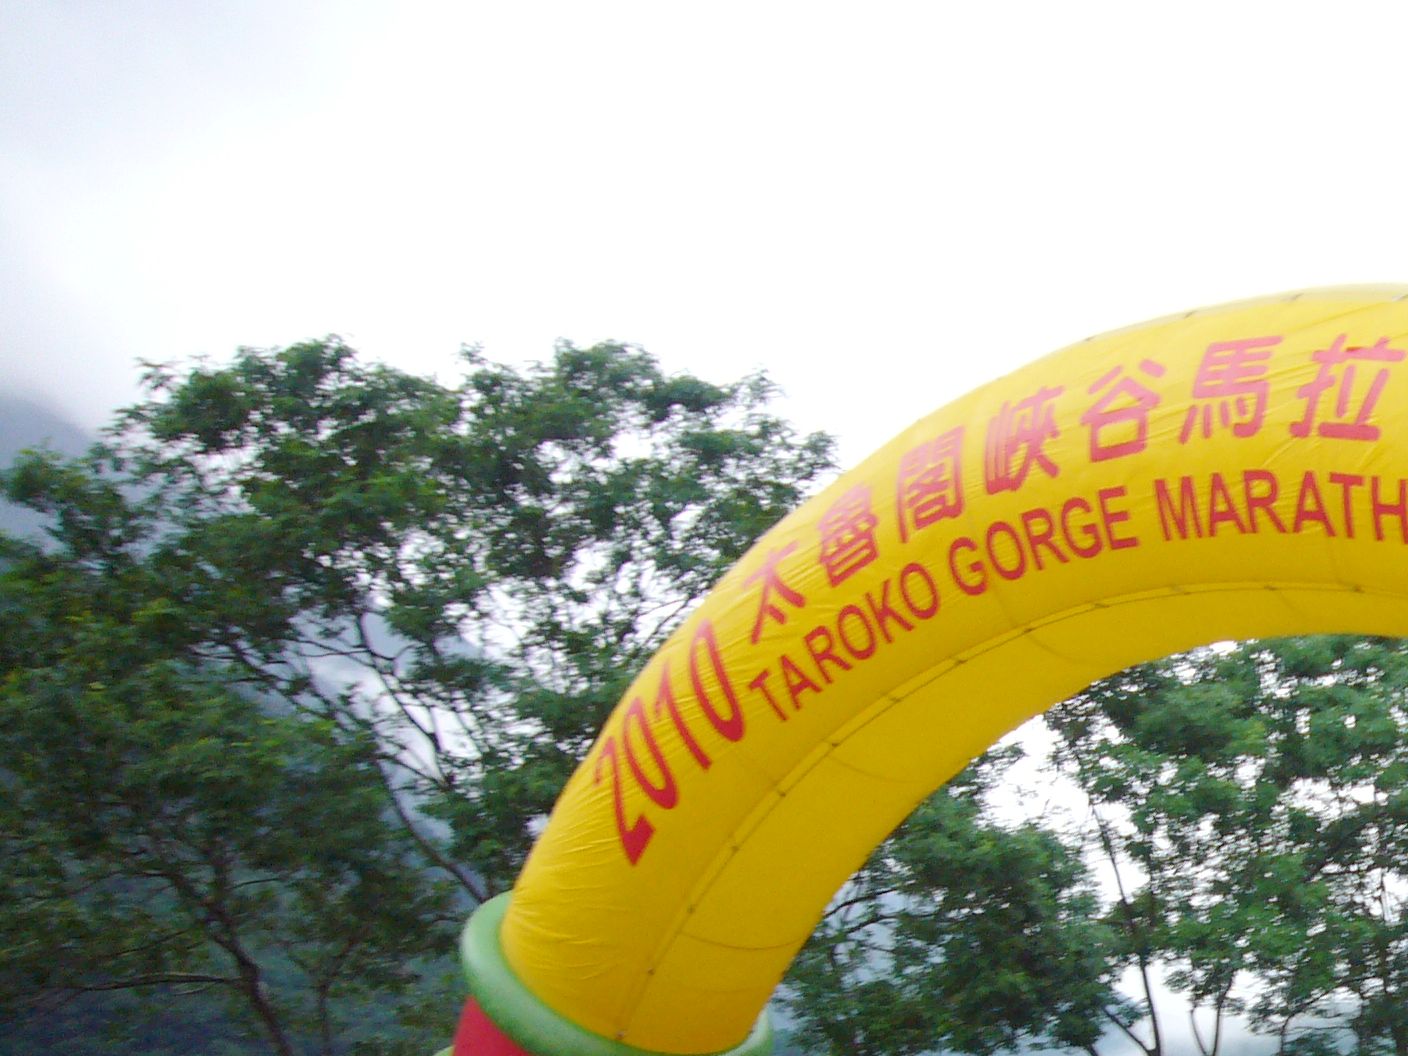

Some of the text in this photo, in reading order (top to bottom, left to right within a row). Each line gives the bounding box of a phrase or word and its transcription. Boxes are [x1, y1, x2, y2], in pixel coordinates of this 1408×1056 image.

[749, 562, 940, 722] TAROKO
[949, 486, 1140, 596] GORGE
[594, 618, 744, 866] 2010
